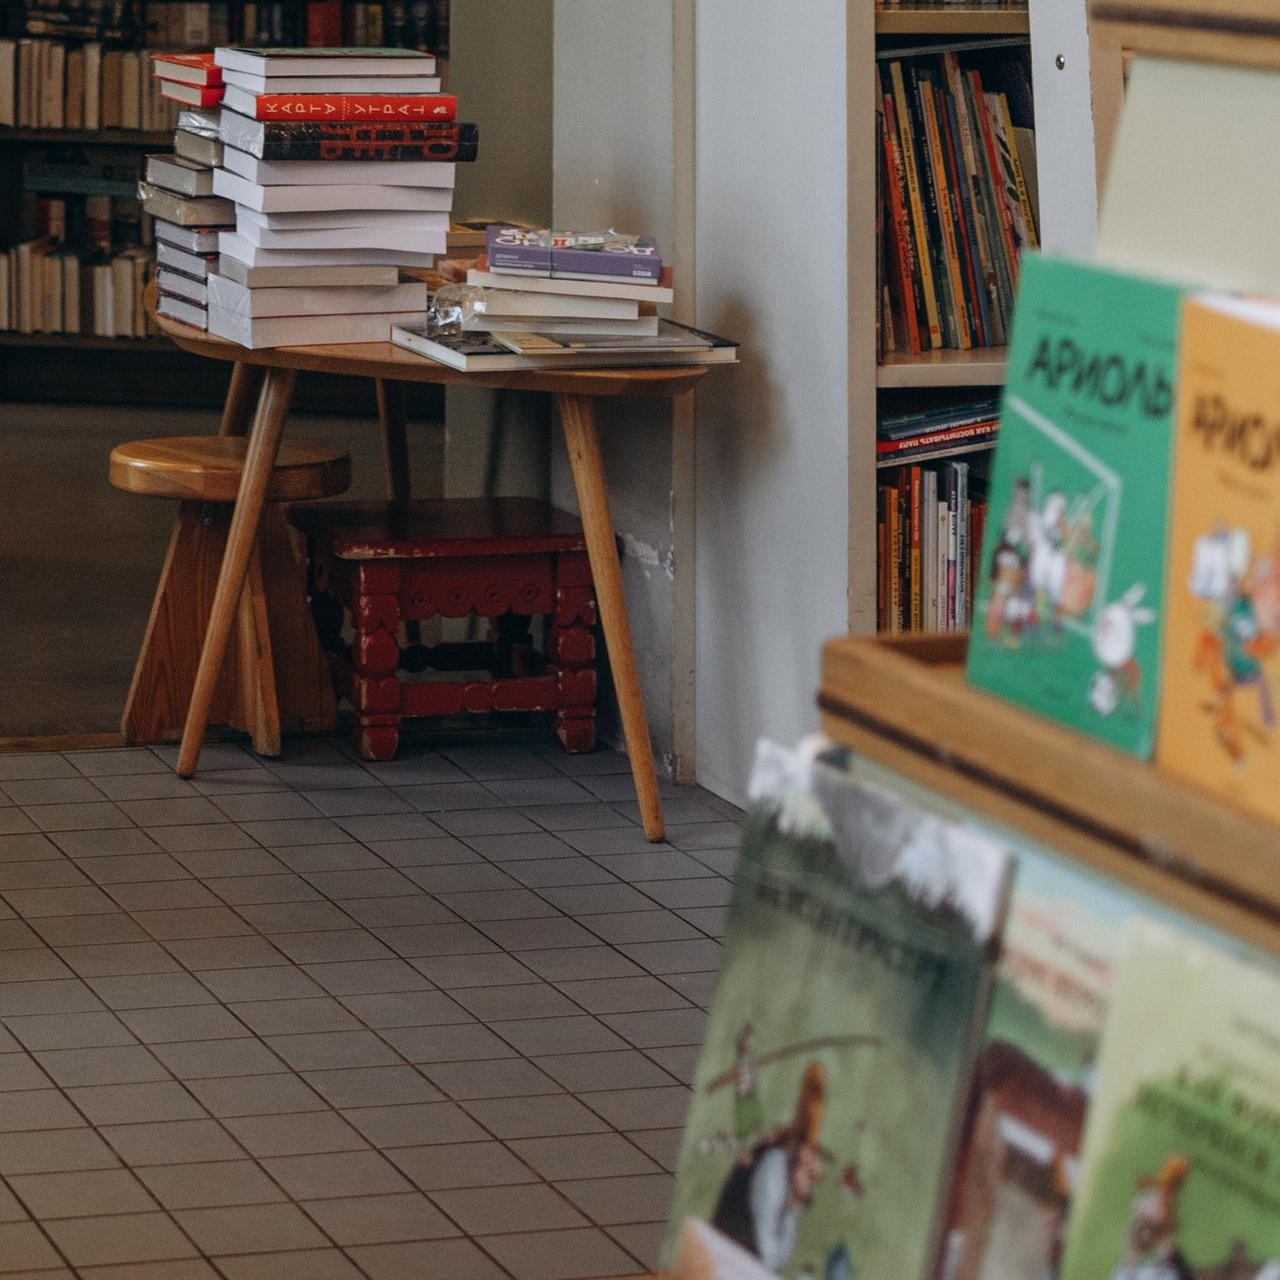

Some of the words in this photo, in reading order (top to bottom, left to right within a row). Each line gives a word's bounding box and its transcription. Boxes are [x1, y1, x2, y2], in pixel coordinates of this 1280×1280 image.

[266, 101, 336, 115] КАРТА
[355, 102, 425, 116] УТРАТ
[1027, 333, 1173, 419] АРИОЛЬ
